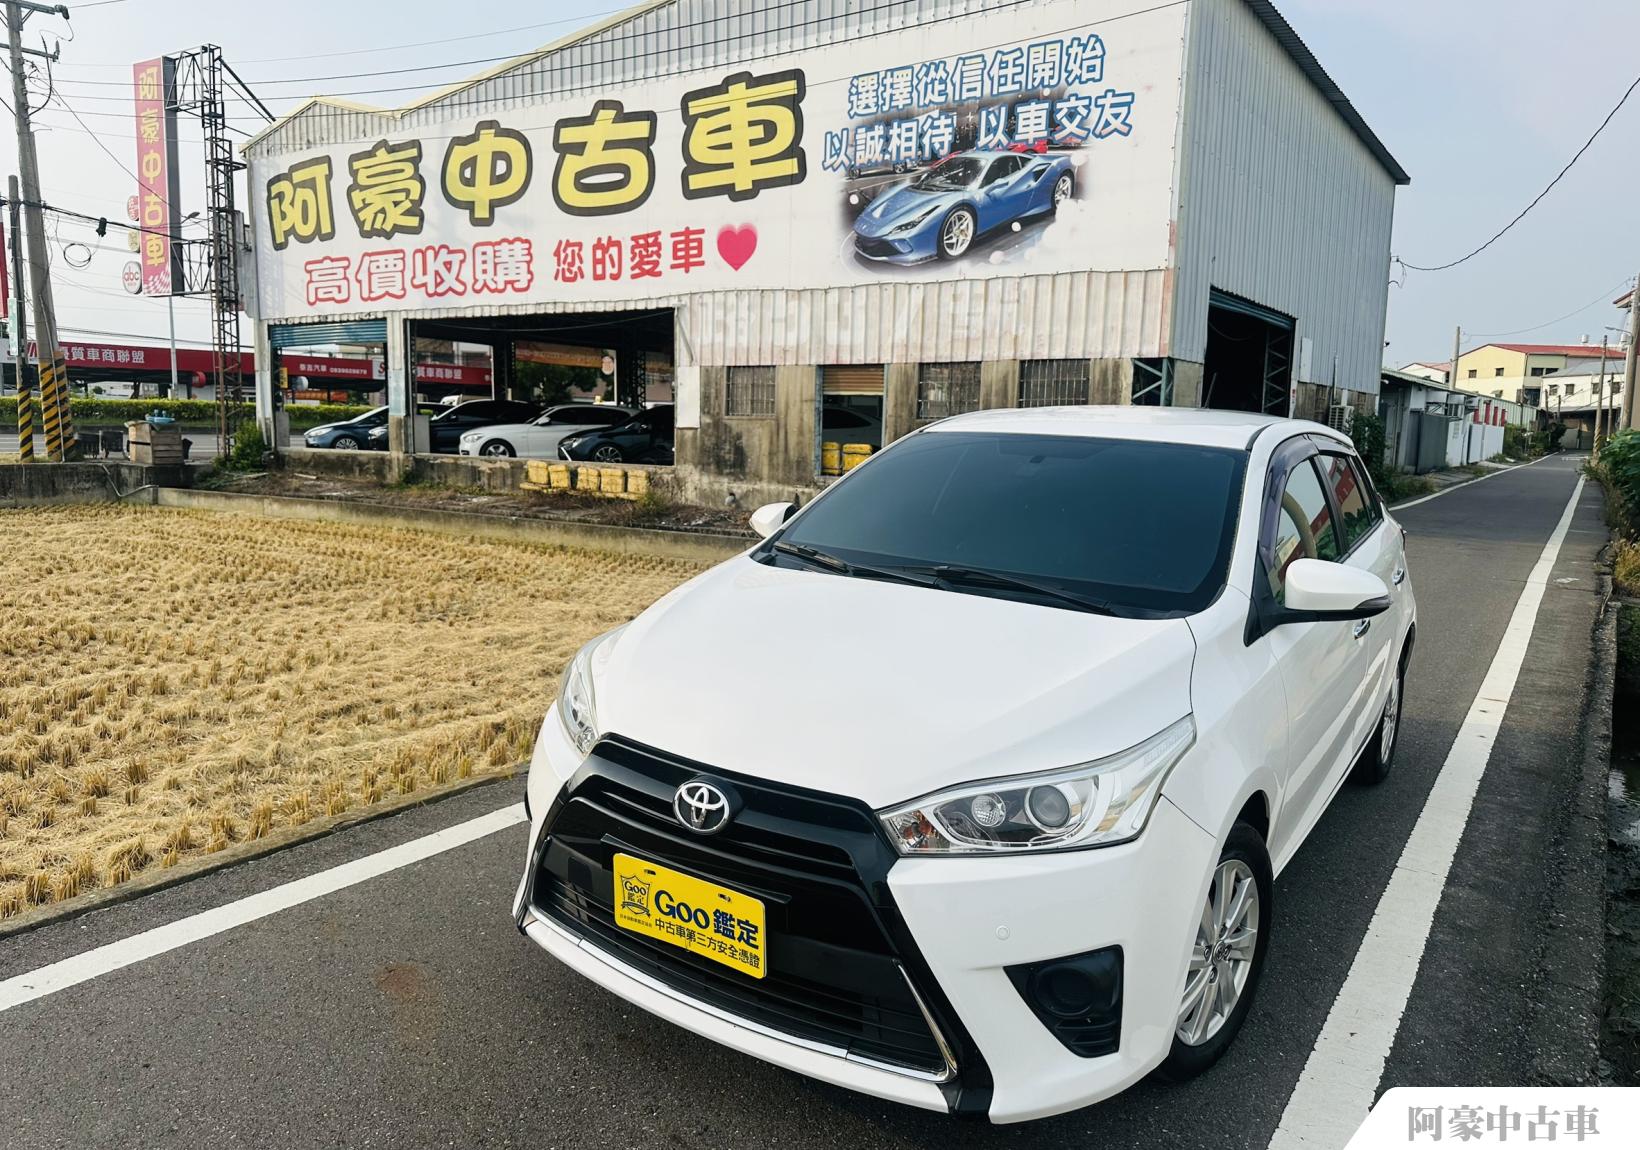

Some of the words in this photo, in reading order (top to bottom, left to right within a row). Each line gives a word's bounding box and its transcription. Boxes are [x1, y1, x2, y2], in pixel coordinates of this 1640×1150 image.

[848, 34, 1106, 118] 選擇從信任開始
[139, 65, 166, 267] 阿豪中古車
[267, 68, 807, 251] 阿豪中古車
[821, 109, 956, 173] 以誠相待
[976, 89, 1135, 152] 以車交友
[305, 236, 534, 306] 高價收購
[552, 226, 706, 283] 您的愛車
[624, 880, 647, 896] Goo
